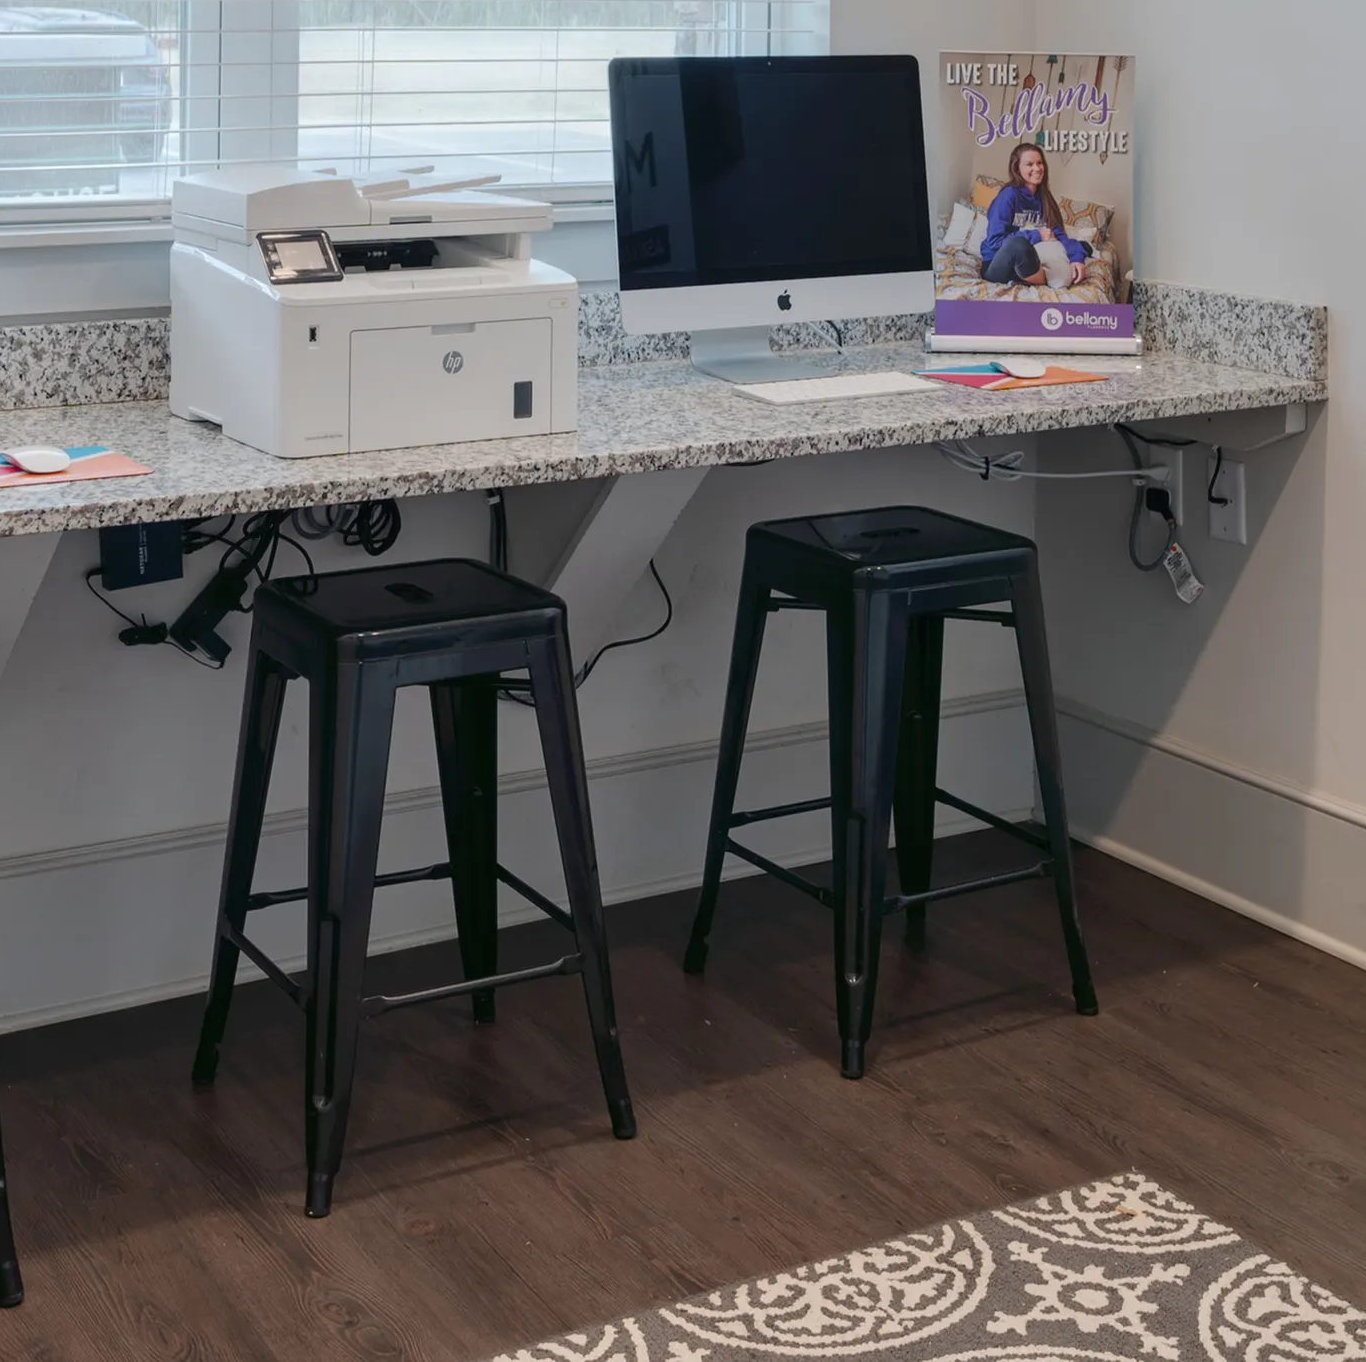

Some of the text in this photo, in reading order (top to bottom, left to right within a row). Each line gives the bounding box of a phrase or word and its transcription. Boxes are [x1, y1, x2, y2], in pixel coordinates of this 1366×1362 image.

[946, 62, 1018, 86] LIVE THE
[961, 81, 1118, 148] Bellamy
[1044, 130, 1128, 153] LIFESTYLE
[1065, 310, 1118, 330] bellamy
[443, 350, 464, 374] hp
